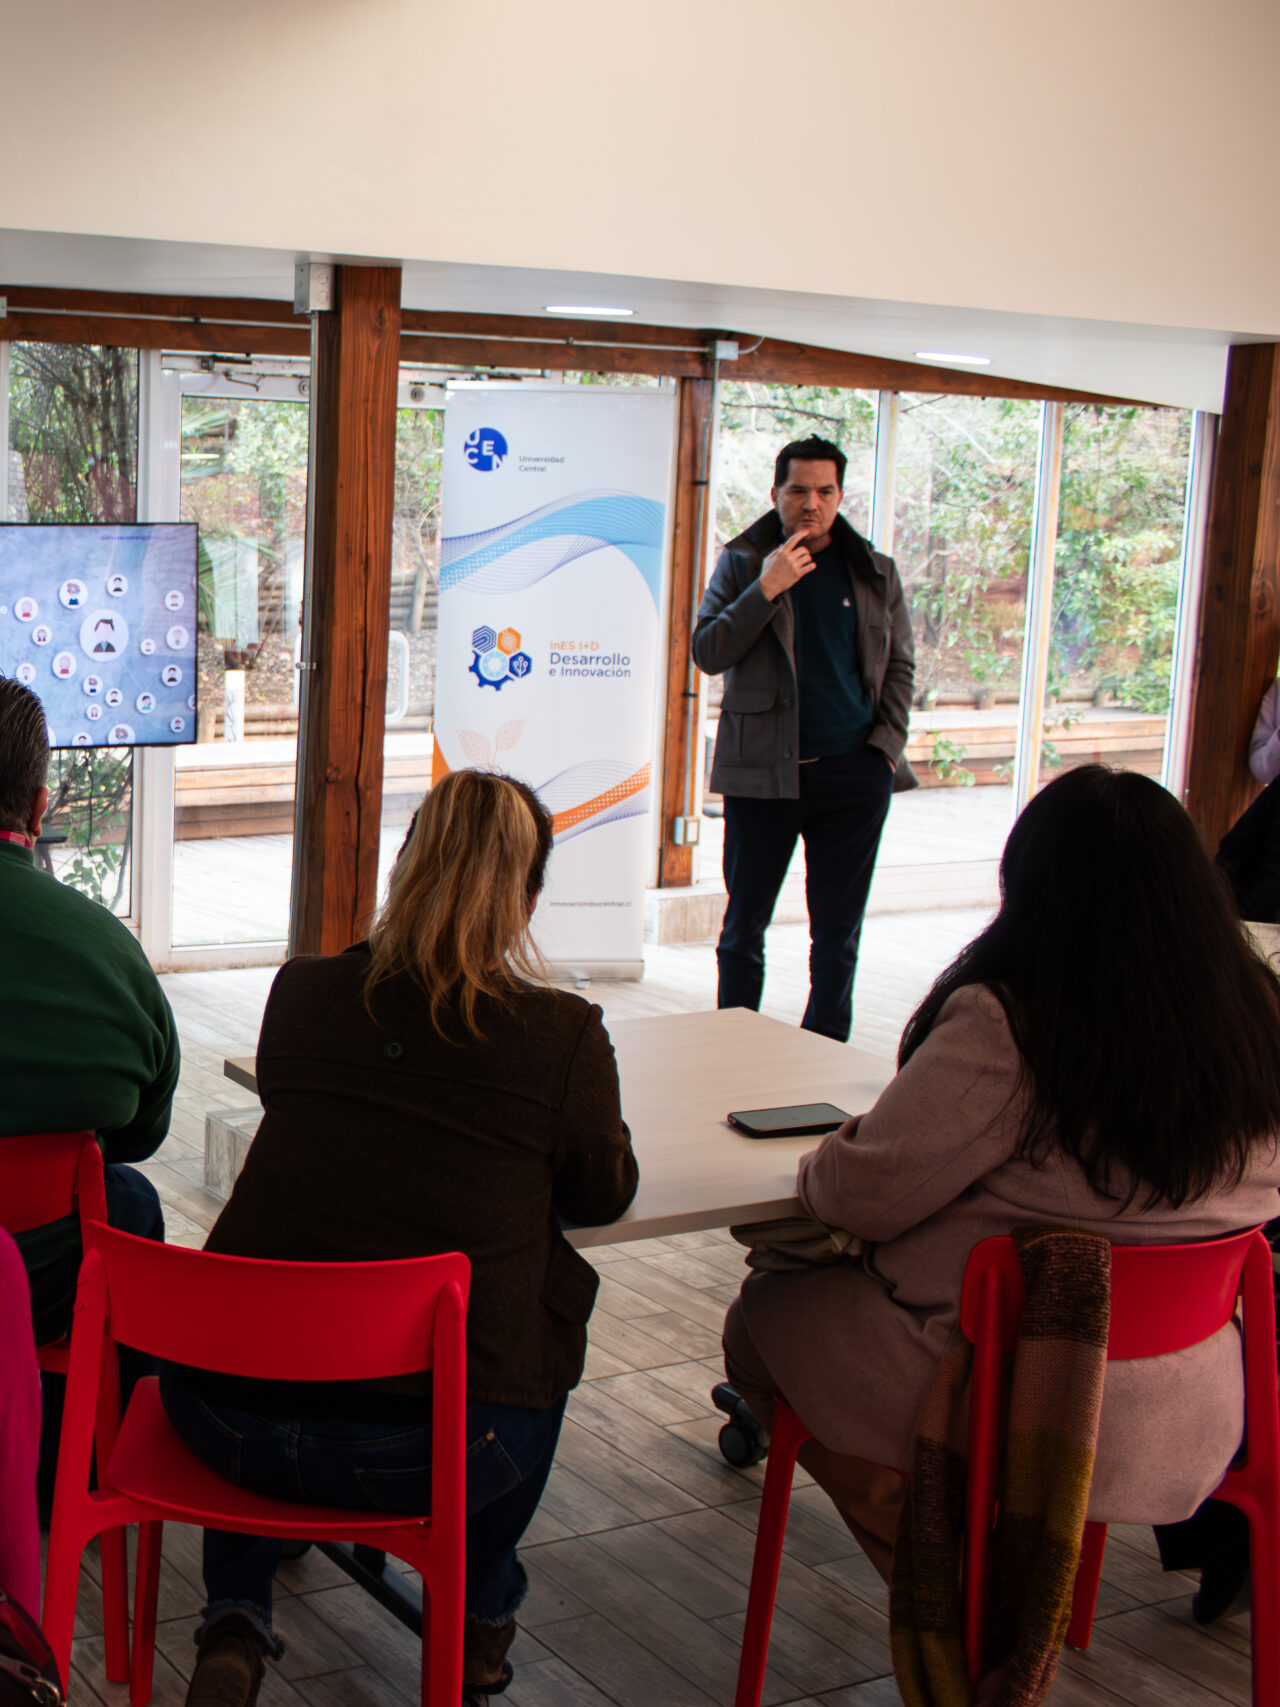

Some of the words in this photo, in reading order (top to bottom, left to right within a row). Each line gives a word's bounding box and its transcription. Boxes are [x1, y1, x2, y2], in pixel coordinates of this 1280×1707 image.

[519, 455, 565, 463] Universidad
[550, 652, 631, 666] Desarrollo
[549, 668, 557, 676] e
[561, 666, 631, 677] Innovación
